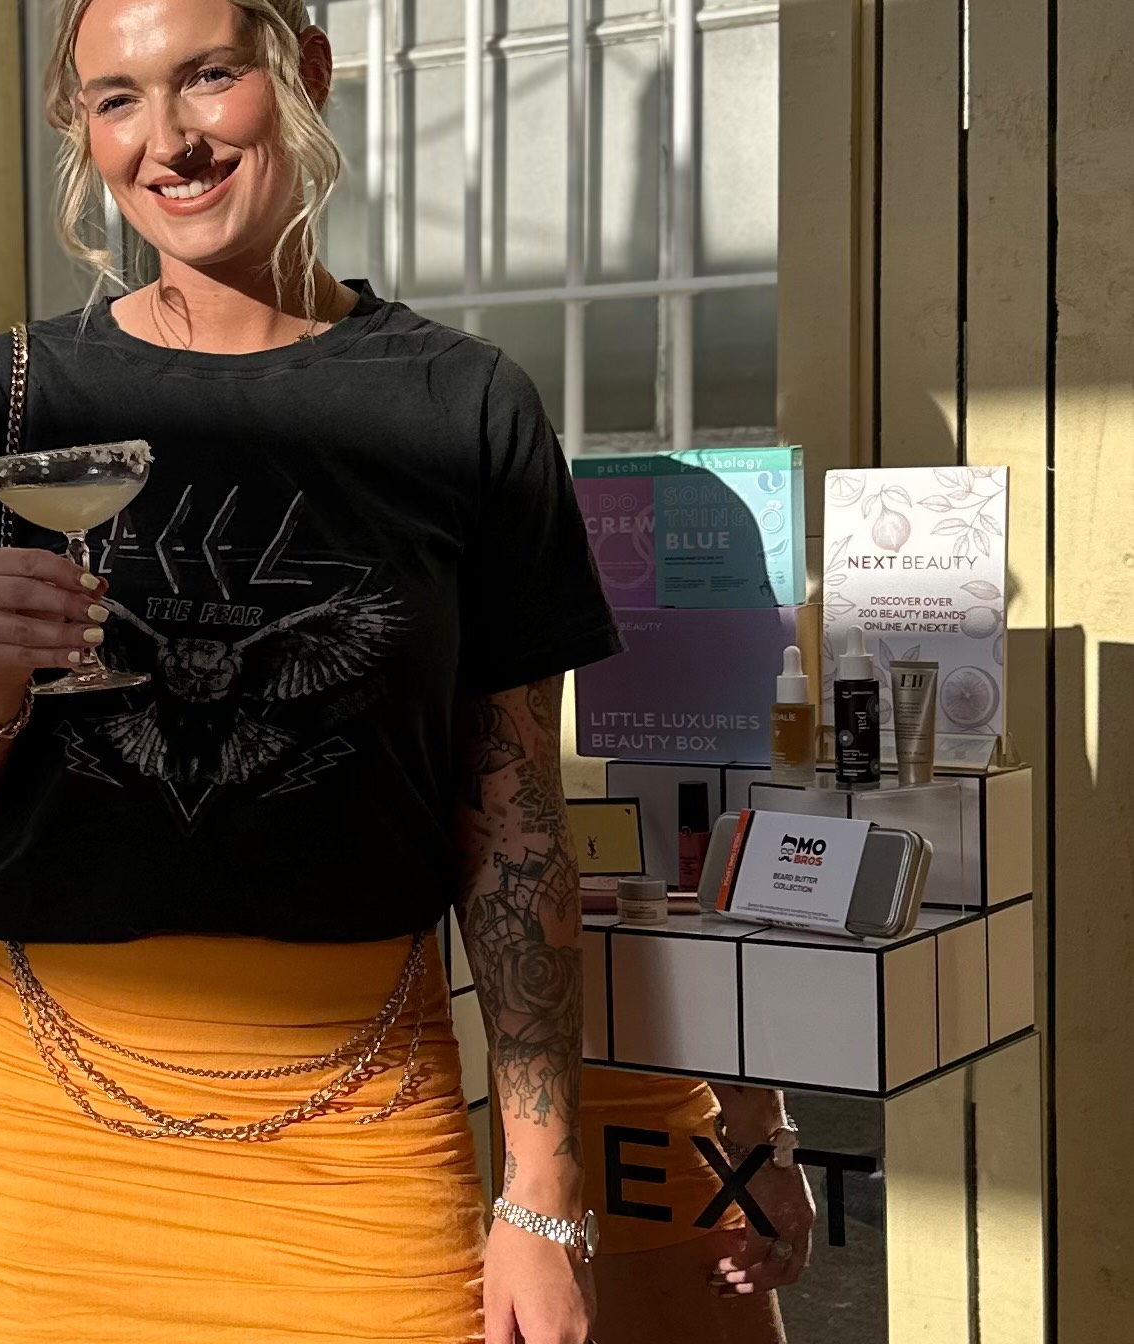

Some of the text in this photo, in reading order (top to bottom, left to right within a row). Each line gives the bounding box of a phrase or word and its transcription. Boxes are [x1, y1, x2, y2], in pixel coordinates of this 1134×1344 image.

[597, 462, 652, 476] patchol
[599, 493, 637, 513] DO
[663, 508, 750, 527] THING
[665, 531, 731, 550] BLUE
[848, 556, 978, 570] NEXT BEAUTY
[870, 596, 953, 607] DISCOVER OVER
[146, 597, 264, 626] THE FEAR
[857, 609, 966, 620] 200 BEAUTY BRANDS
[619, 622, 662, 631] BEAUTY
[864, 622, 902, 632] ONLINE
[904, 622, 917, 632] AT
[590, 712, 760, 730] LITTLE LUXURIES
[591, 734, 717, 751] BEAUTY BOX
[796, 837, 827, 856] MO
[793, 856, 823, 866] BROS
[773, 872, 794, 882] BEARD
[773, 882, 813, 894] COLLECTION
[603, 1124, 878, 1247] EXT
